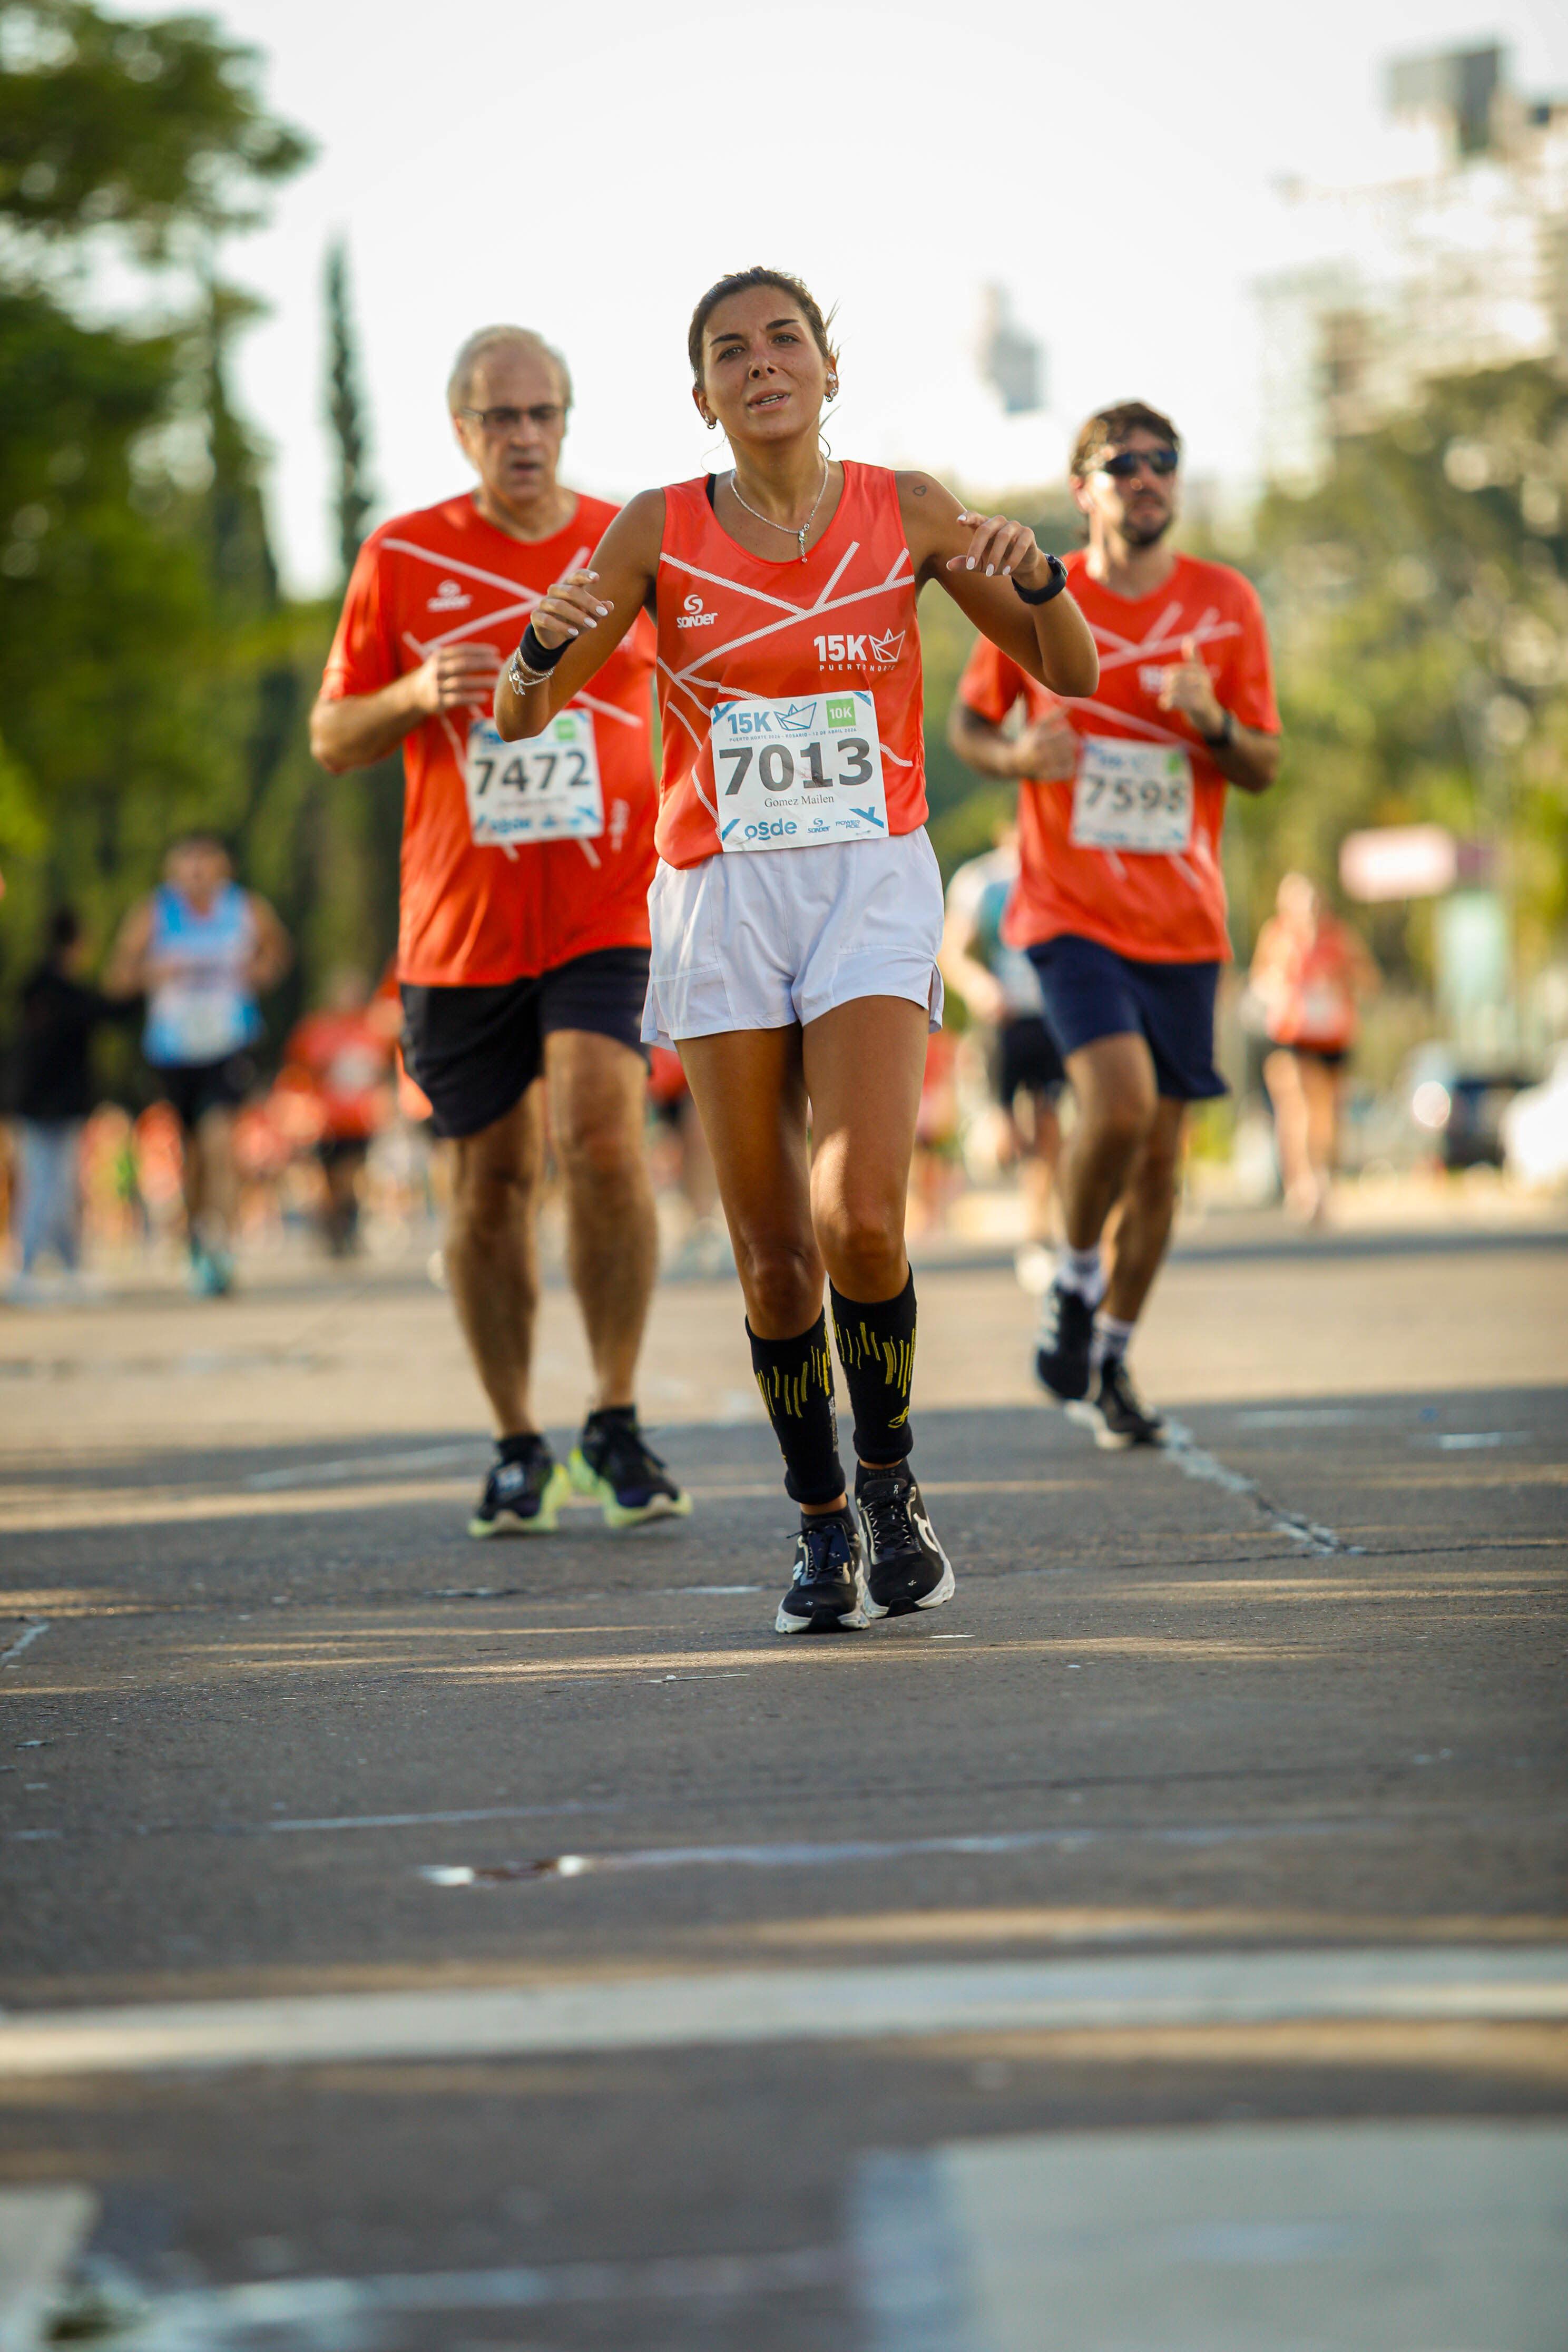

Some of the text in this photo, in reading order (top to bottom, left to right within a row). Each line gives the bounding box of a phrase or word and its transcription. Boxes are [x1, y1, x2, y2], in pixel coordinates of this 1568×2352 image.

[814, 634, 867, 662] 15K
[819, 663, 866, 672] PUERTO
[727, 711, 772, 734] 15K
[829, 707, 852, 720] 10K
[474, 750, 591, 796] 7472
[719, 737, 873, 796] 7013
[764, 795, 835, 808] Gomez Mailen
[744, 817, 797, 840] osde
